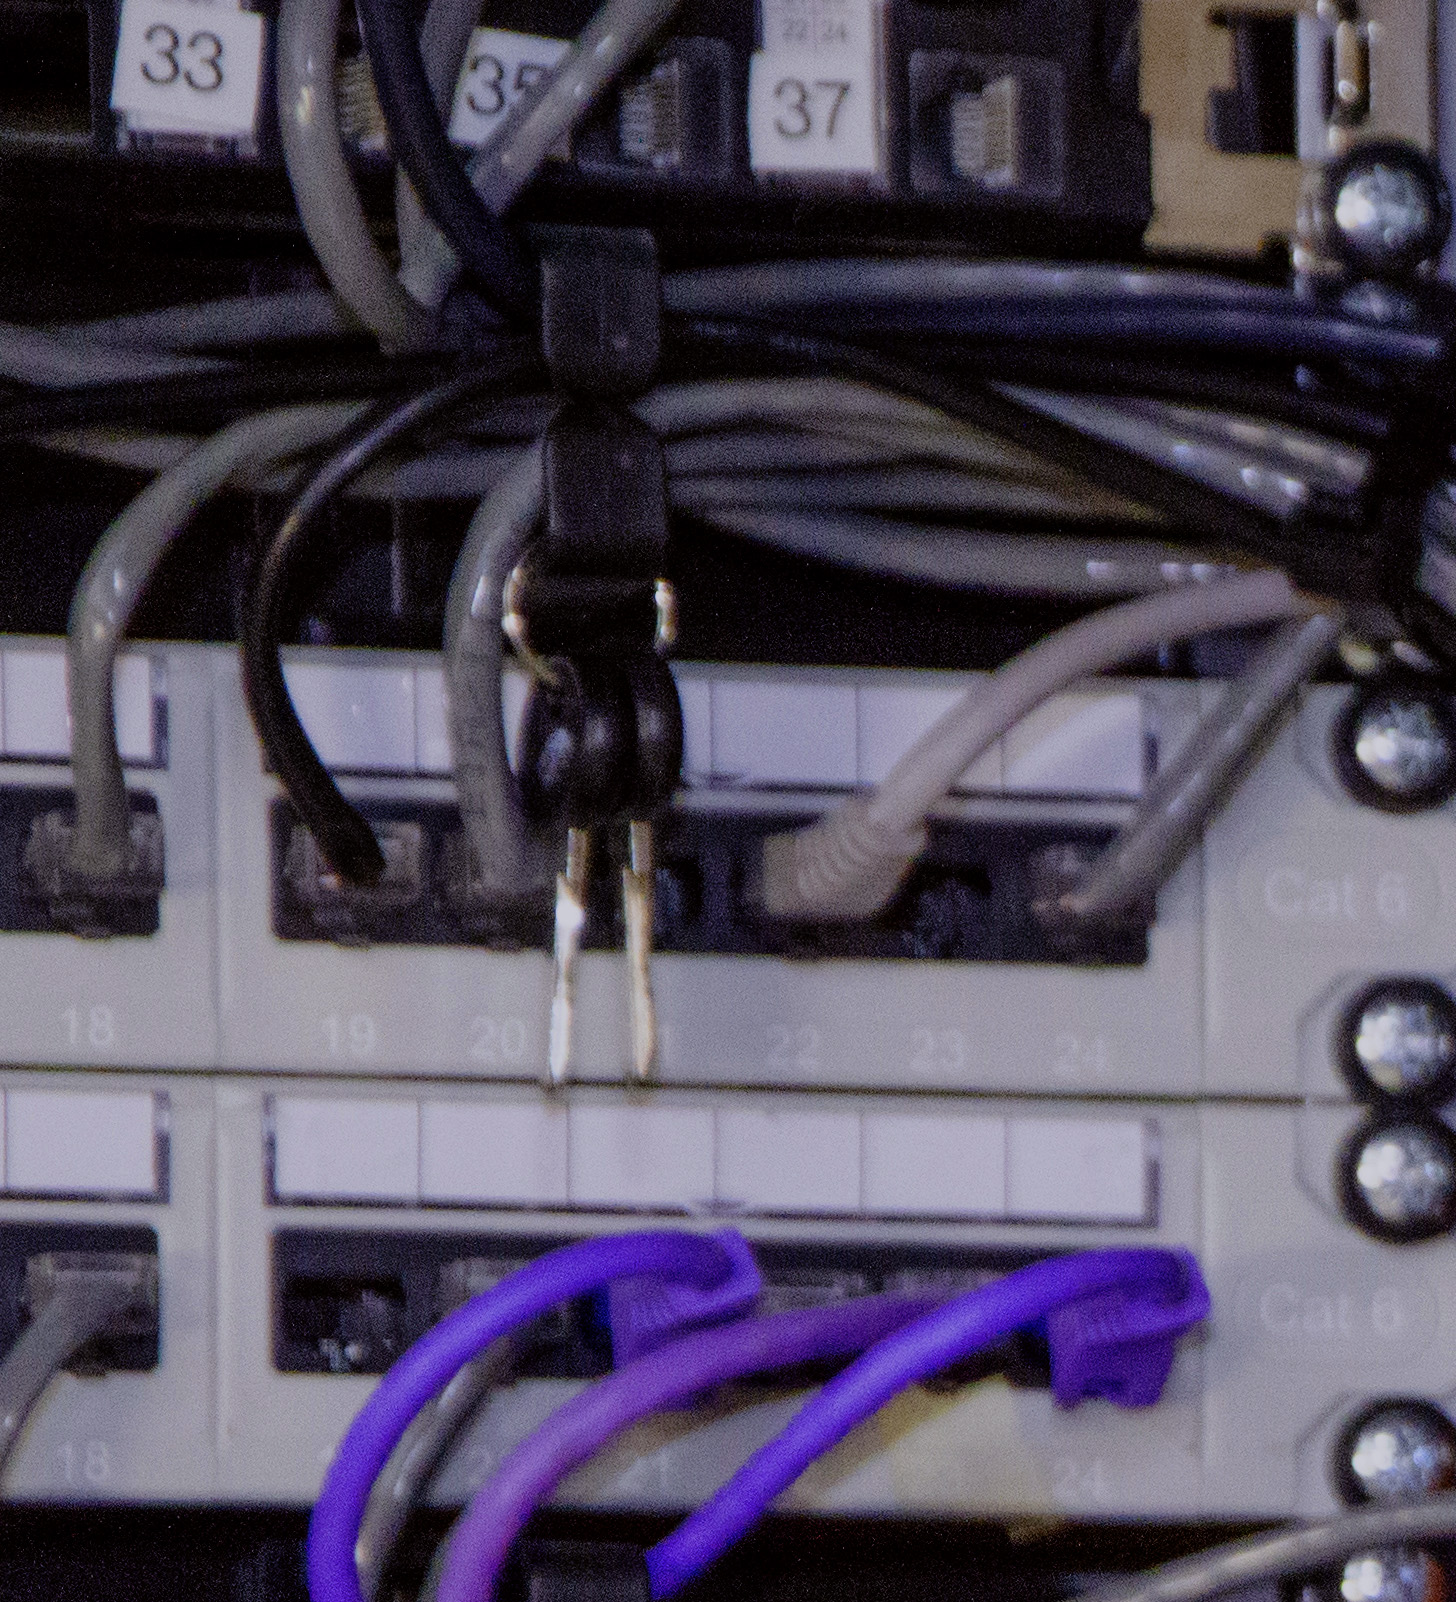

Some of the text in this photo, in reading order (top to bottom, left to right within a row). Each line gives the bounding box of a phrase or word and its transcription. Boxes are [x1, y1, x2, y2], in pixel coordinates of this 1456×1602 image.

[140, 22, 224, 93] 33
[774, 77, 852, 139] 37
[1263, 867, 1408, 923] Cat 6
[60, 1005, 116, 1048] 18
[321, 1012, 377, 1058] 19
[470, 1016, 528, 1060] 20
[766, 1024, 821, 1070] 22
[910, 1028, 966, 1073] 23
[1053, 1034, 1109, 1075] 24
[1259, 1283, 1403, 1338] Cat 6
[57, 1441, 112, 1484] 18
